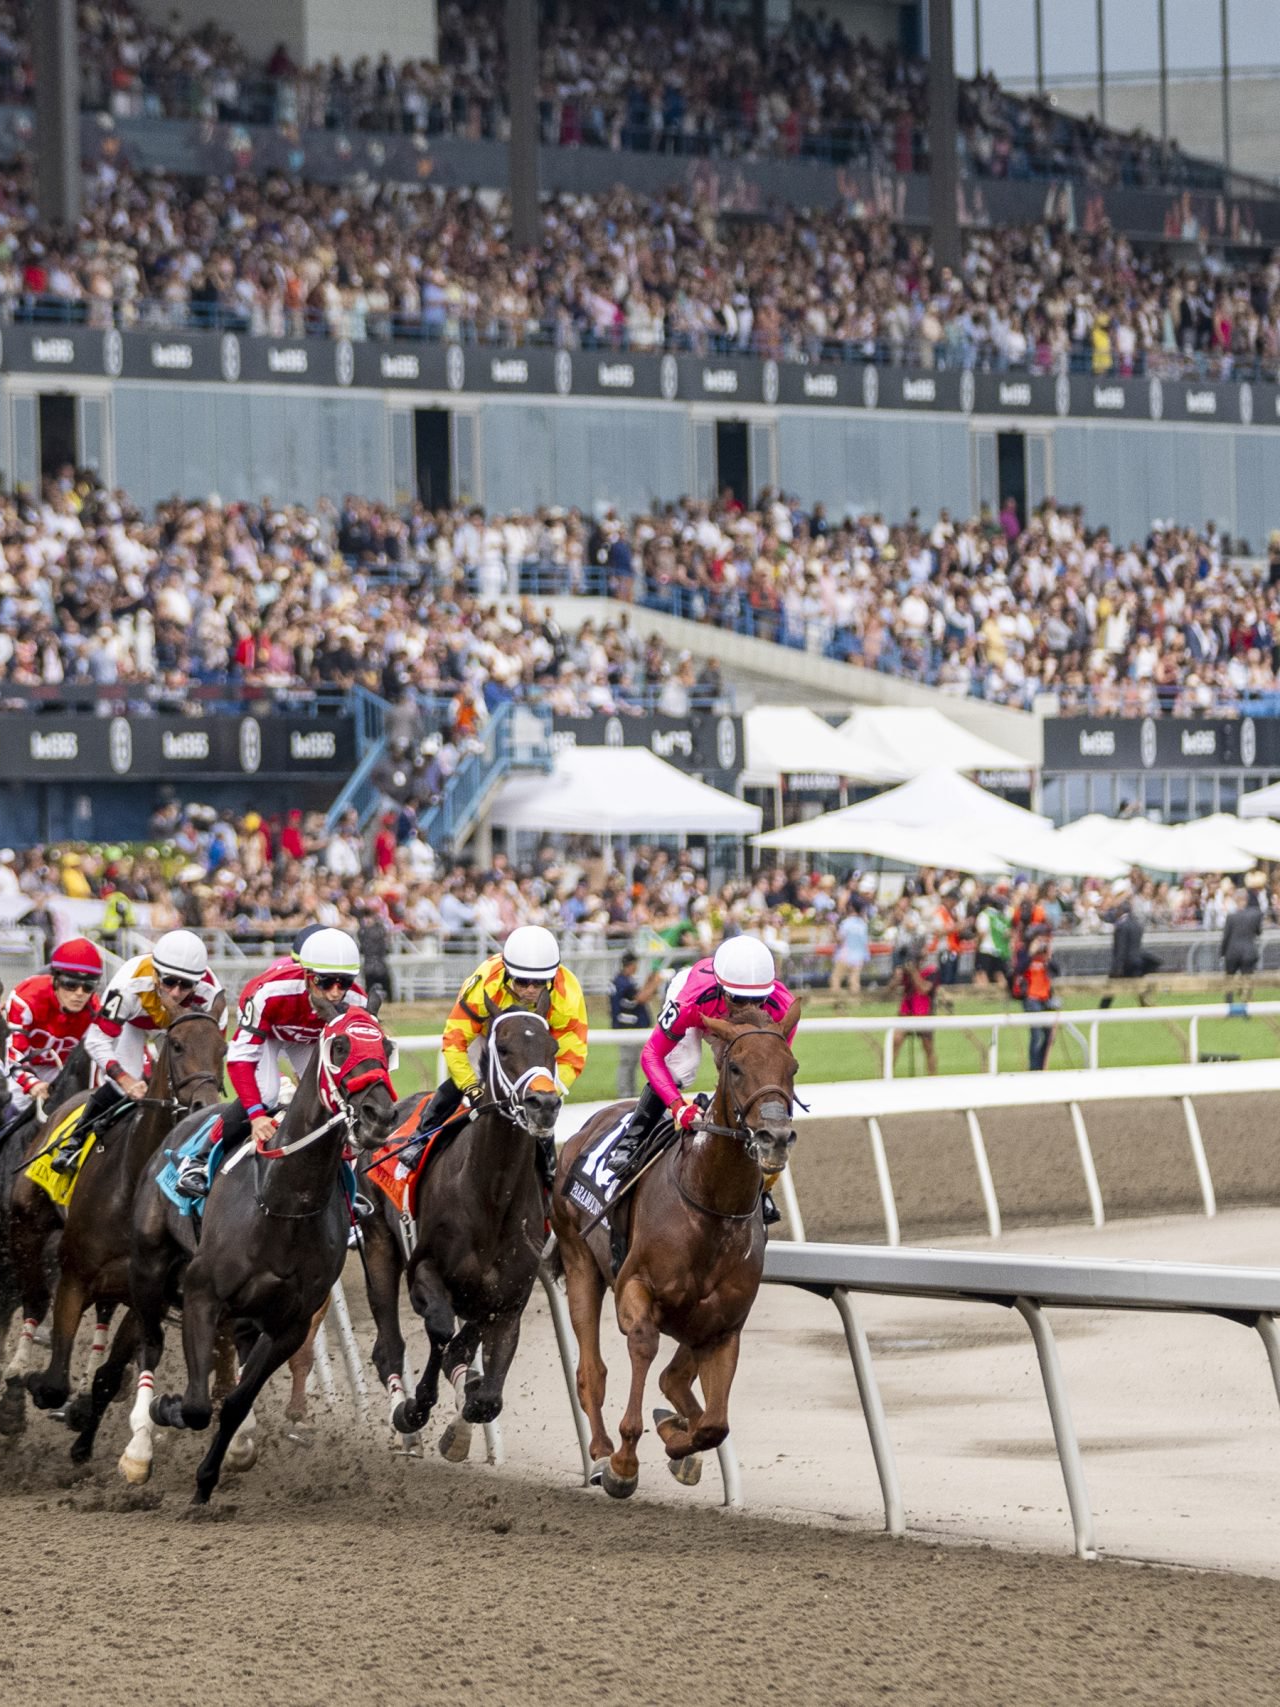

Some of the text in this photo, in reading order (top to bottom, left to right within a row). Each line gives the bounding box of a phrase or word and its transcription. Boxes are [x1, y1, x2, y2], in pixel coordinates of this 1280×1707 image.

[105, 995, 121, 1020] 4
[241, 1001, 254, 1027] 9
[658, 1002, 677, 1030] 13
